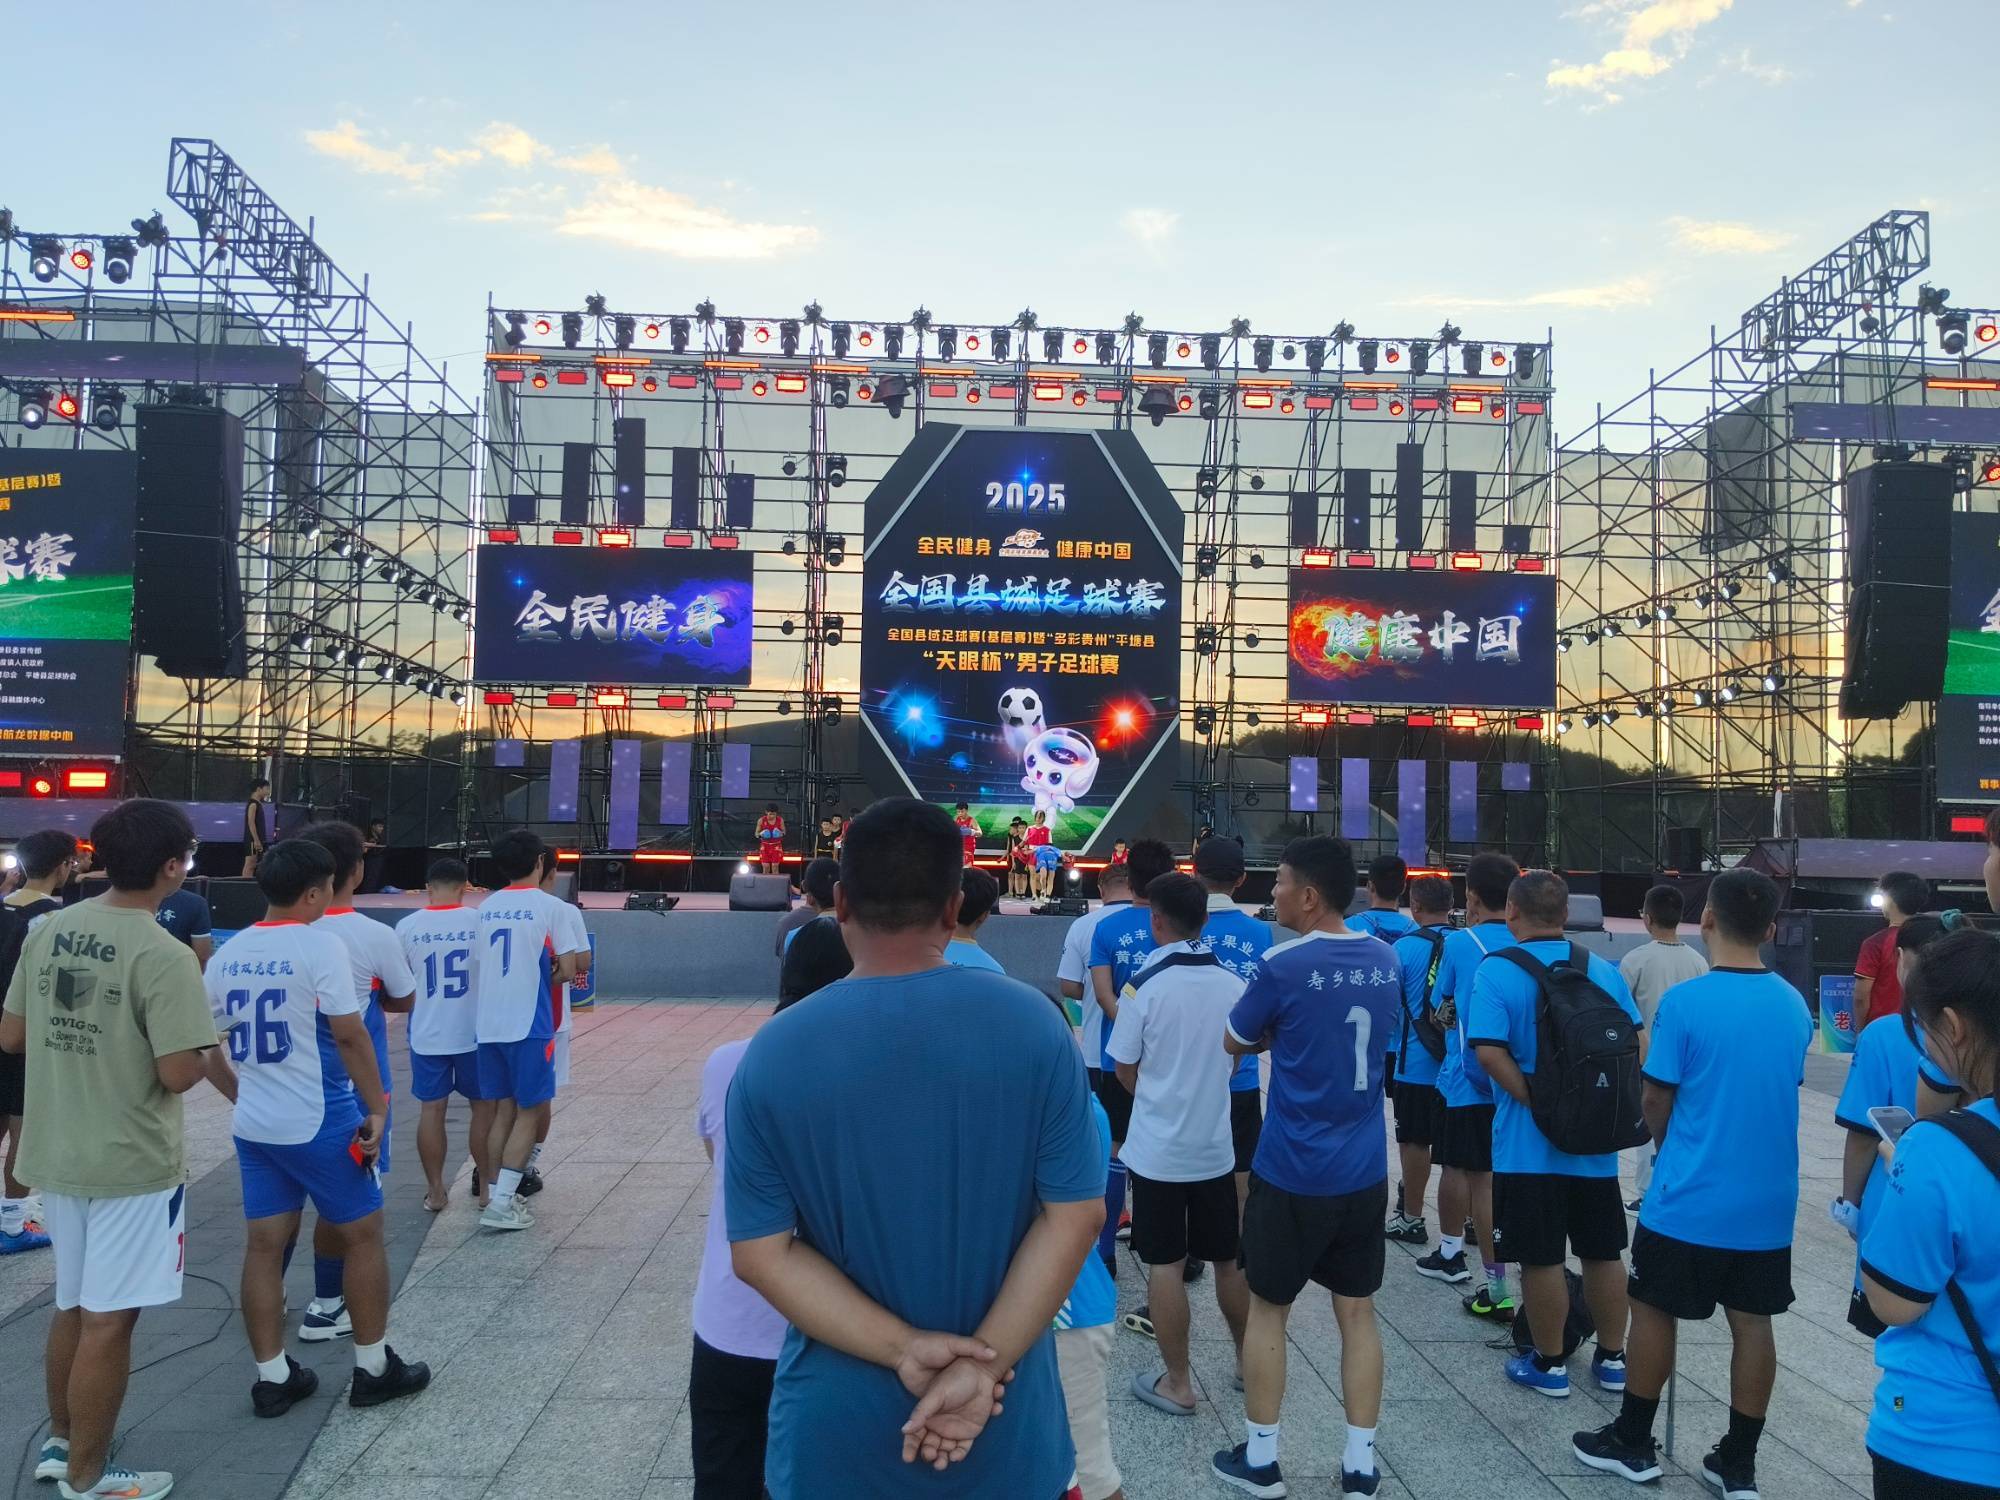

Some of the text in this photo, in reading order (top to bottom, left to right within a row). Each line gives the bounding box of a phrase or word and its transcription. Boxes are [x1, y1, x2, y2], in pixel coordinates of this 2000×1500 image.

[985, 481, 1066, 514] 2025
[917, 536, 992, 556] 全民健身
[1056, 540, 1132, 560] 健康中国
[513, 589, 726, 649] 全民健身
[1323, 609, 1523, 664] 健康中国
[0, 695, 45, 704] 县融媒体中心
[51, 931, 116, 962] Nike
[490, 928, 511, 978] 7
[424, 949, 469, 998] 15
[226, 988, 293, 1064] 66
[1345, 1006, 1371, 1091] 1
[1596, 1072, 1609, 1087] A
